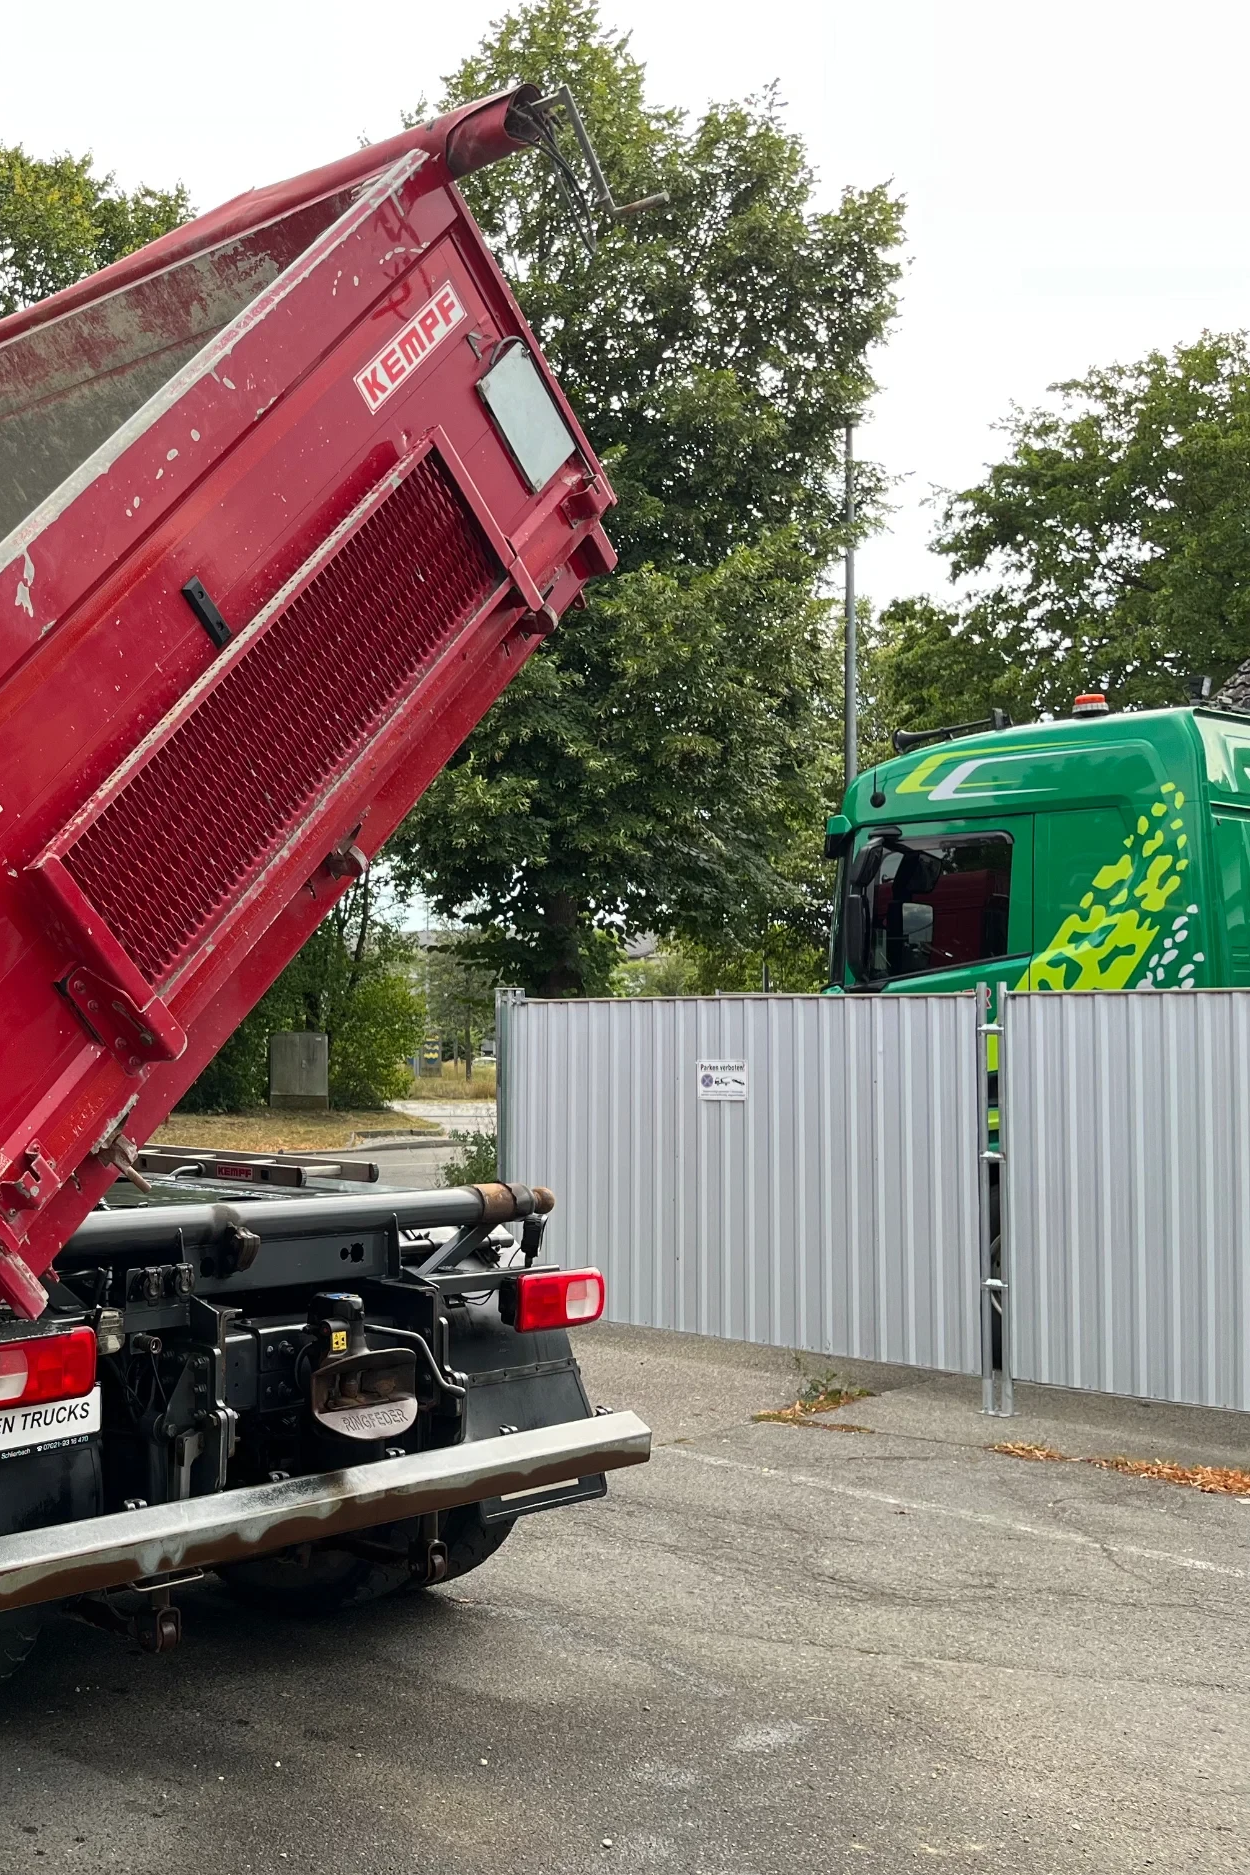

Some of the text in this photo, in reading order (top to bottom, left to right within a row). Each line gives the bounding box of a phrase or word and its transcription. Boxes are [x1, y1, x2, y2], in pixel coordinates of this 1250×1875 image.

[361, 291, 456, 404] KEMPF
[217, 1166, 252, 1178] KEMPF
[21, 1402, 90, 1431] TRUCKS
[341, 1408, 408, 1431] RINGFEDER
